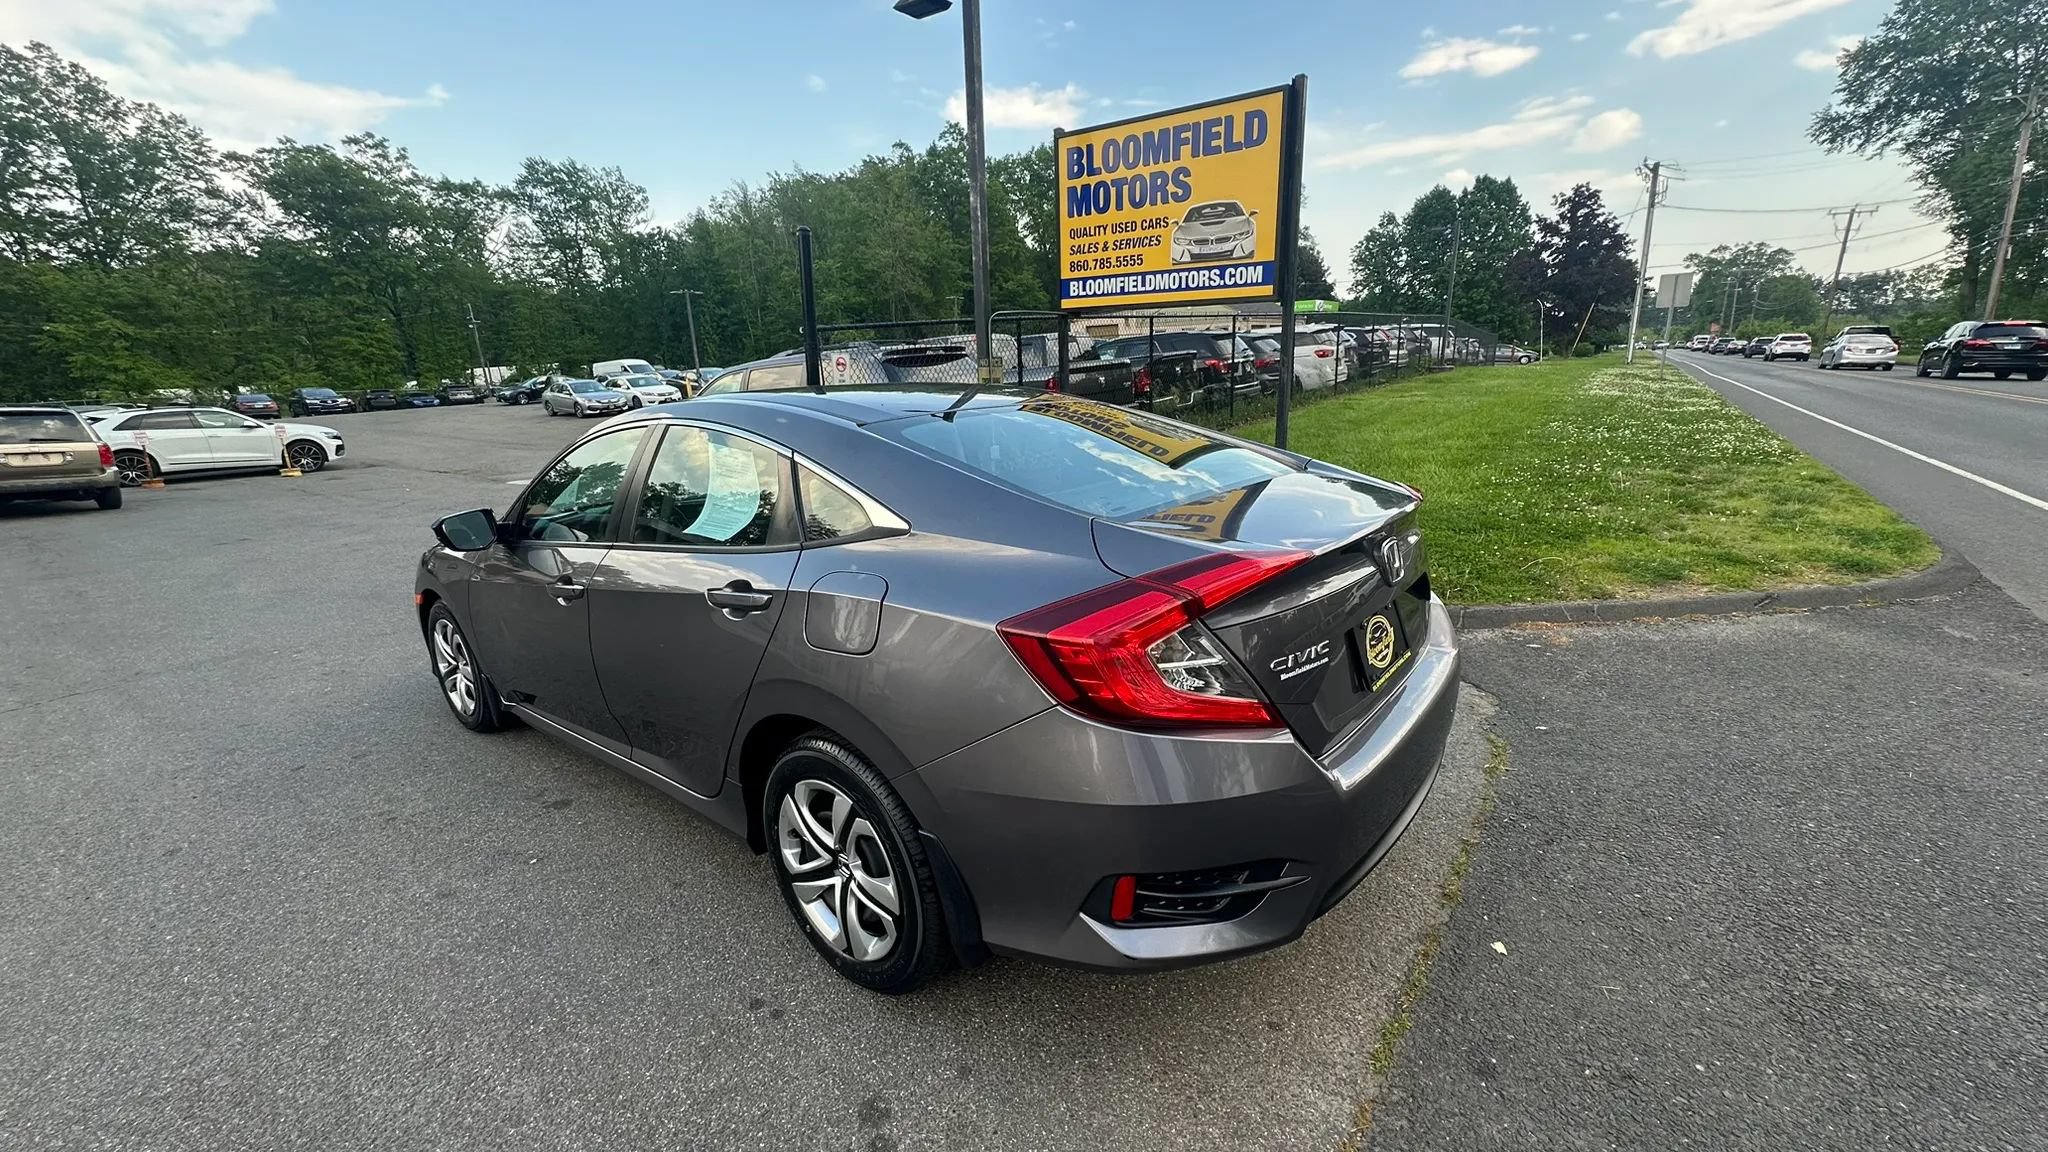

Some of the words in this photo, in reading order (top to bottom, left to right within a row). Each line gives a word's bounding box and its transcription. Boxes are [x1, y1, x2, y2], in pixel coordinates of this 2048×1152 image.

[1066, 108, 1269, 181] BLOOMFIELD
[1066, 166, 1193, 219] MOTORS
[1069, 223, 1108, 240] QUALITY
[1111, 222, 1138, 235] USED
[1140, 217, 1170, 231] CARS
[1069, 242, 1100, 256] SALES
[1101, 241, 1110, 252] &
[1112, 235, 1162, 250] SERVICES
[1069, 254, 1144, 273] 860.785.5555
[1069, 265, 1263, 298] BLOOMFIELDMOTORS.COM
[1270, 640, 1329, 671] CIVIC
